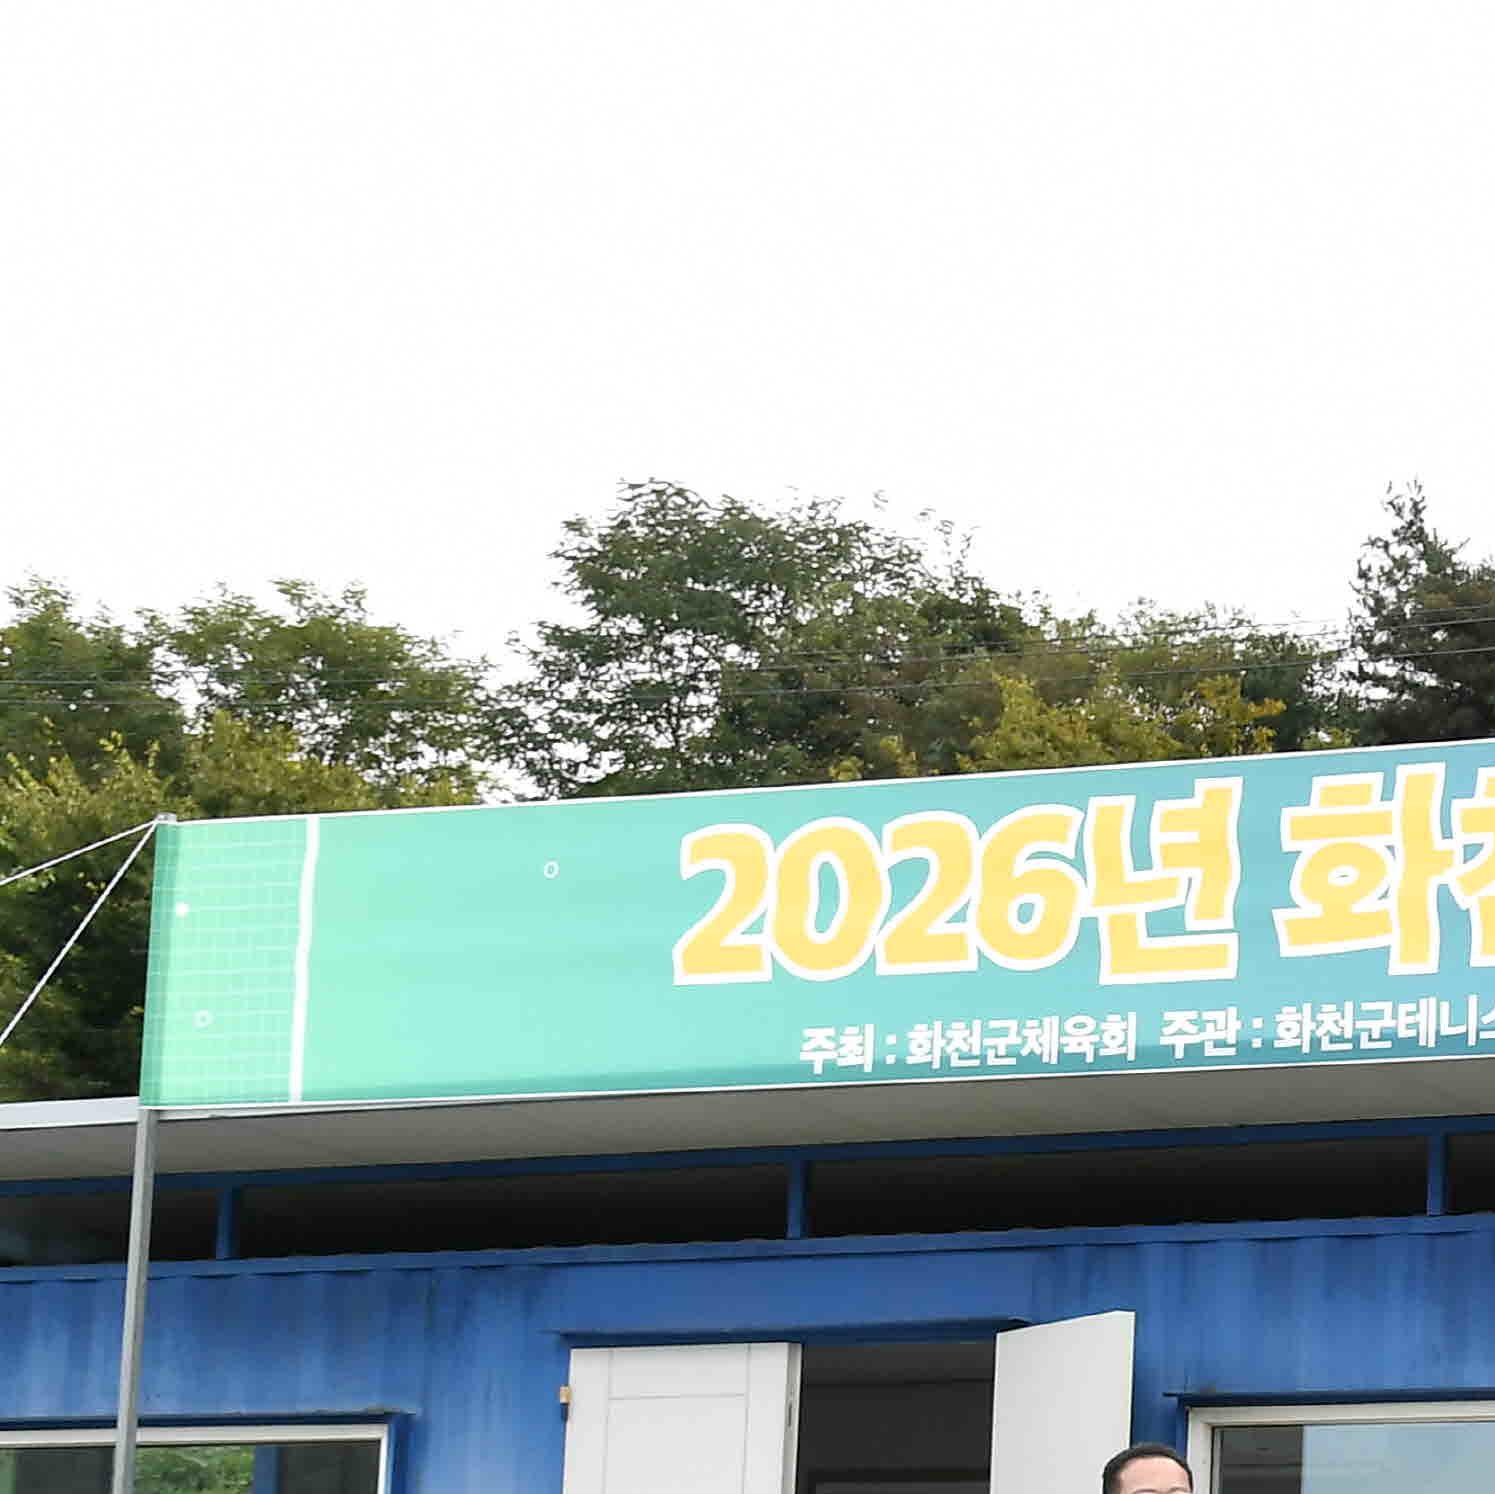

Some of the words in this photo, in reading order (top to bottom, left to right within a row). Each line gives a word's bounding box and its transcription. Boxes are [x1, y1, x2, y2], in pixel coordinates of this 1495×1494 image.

[673, 777, 1242, 986] 2026년
[799, 1023, 875, 1075] 주최
[906, 1011, 1137, 1070] 화천군체육회
[1159, 1006, 1241, 1060] 주관
